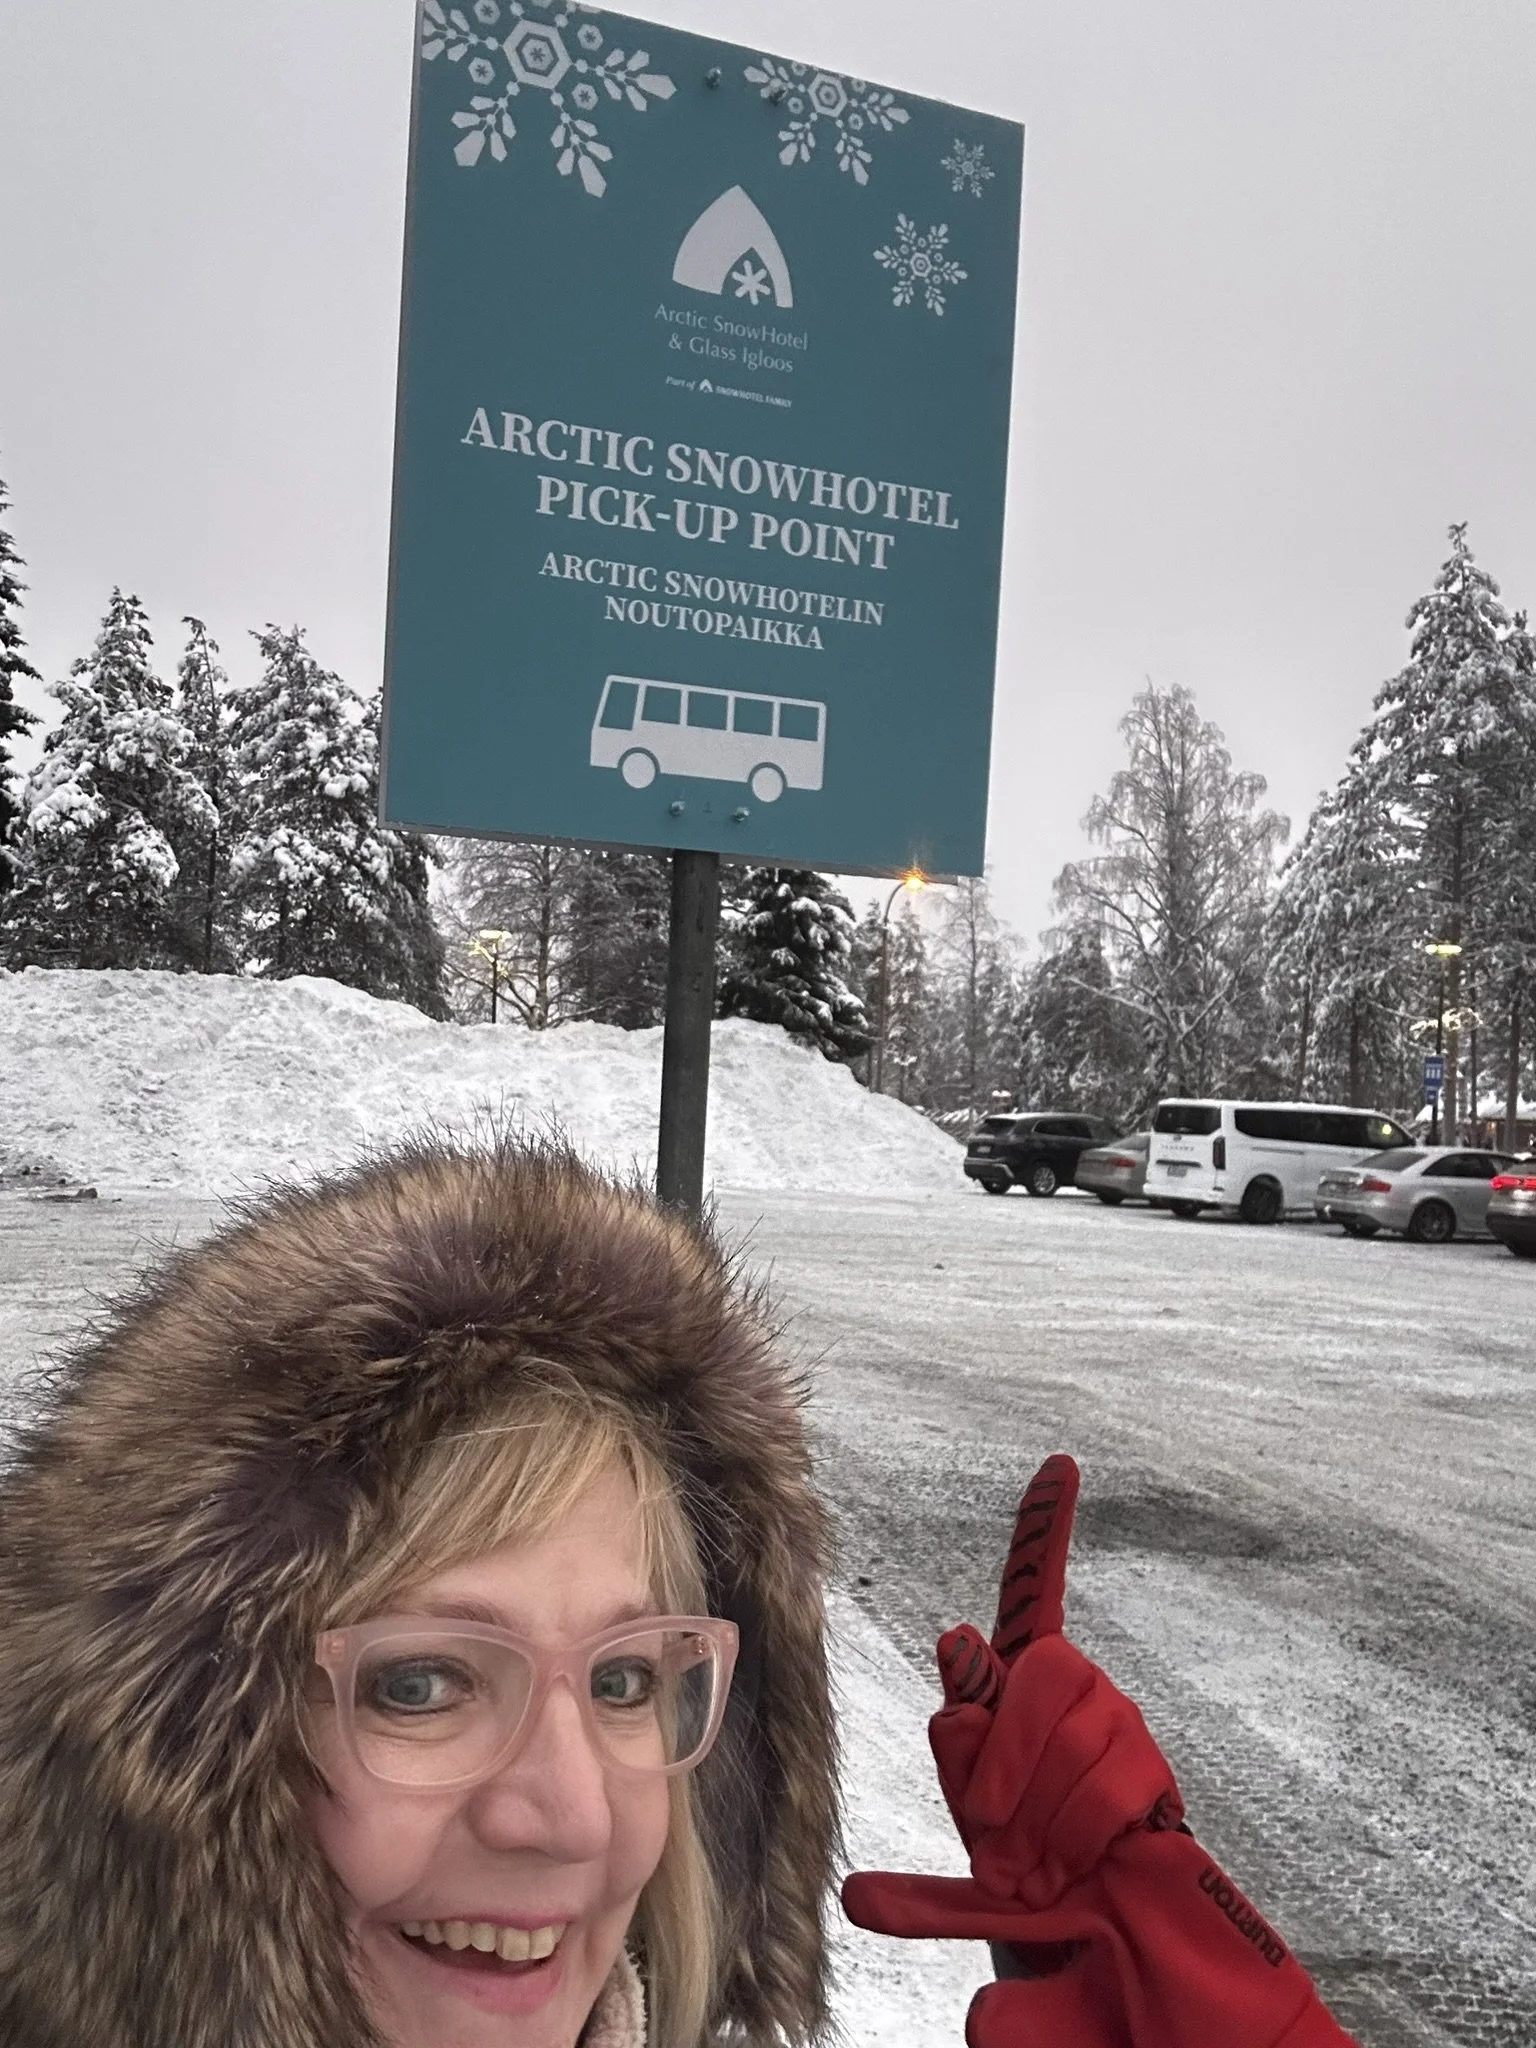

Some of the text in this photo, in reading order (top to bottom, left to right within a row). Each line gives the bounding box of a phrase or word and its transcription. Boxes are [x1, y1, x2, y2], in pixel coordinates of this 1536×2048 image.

[655, 303, 809, 351] Arctic SnowHotel
[668, 332, 793, 373] & Glass Igloos
[686, 380, 697, 391] of
[715, 385, 764, 403] SNOWHOTEL
[460, 406, 960, 530] ARCTIC SNOWHOTEL
[535, 474, 896, 570] PICK-UP POINT
[538, 551, 886, 626] ARCTIC SNOWHOTELIN
[603, 595, 825, 651] NOUTOPAIKKA
